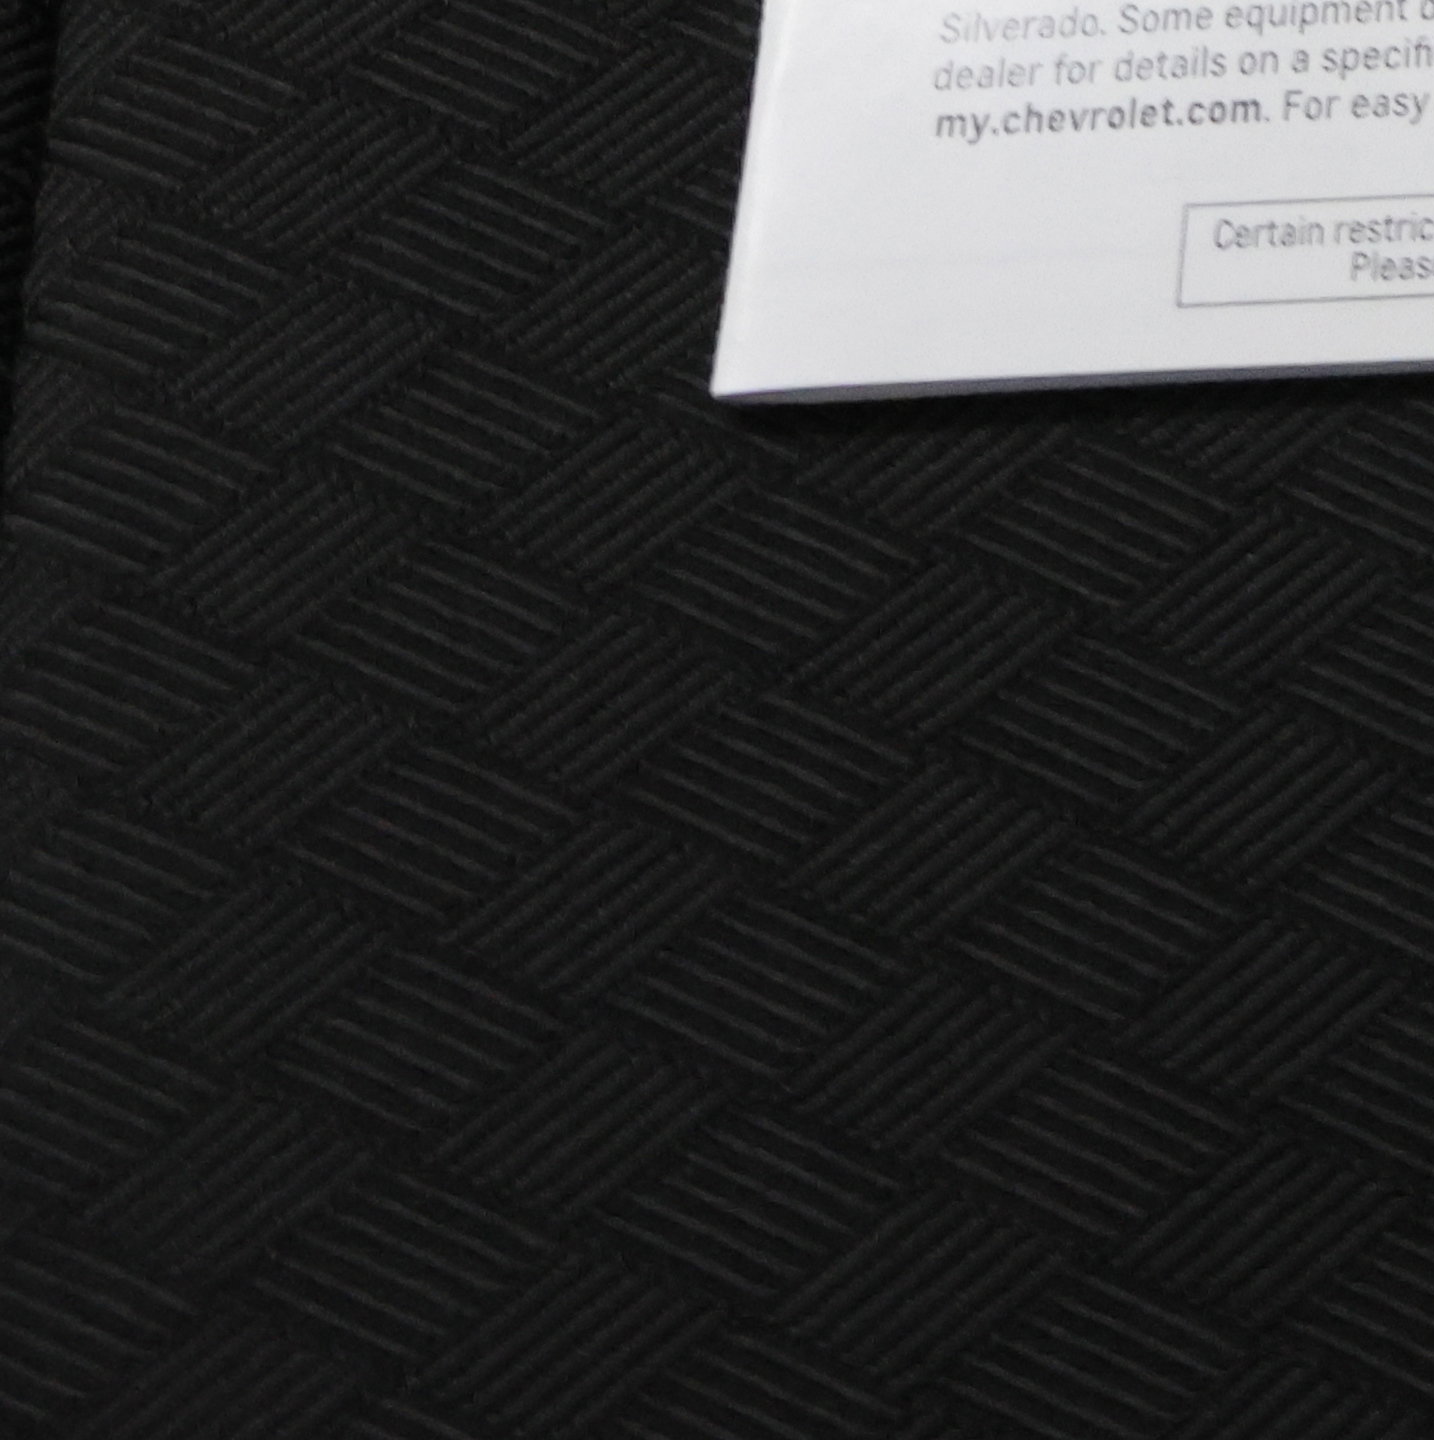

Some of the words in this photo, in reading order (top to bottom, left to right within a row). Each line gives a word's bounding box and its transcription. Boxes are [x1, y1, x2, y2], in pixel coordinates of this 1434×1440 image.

[940, 7, 1106, 44] Silverado.
[1117, 3, 1214, 35] Some
[934, 57, 1043, 90] dealer
[1054, 53, 1102, 84] for
[1113, 45, 1227, 82] details
[1237, 50, 1279, 77] on
[1290, 49, 1310, 74] a
[935, 97, 1270, 145] my.chevrolet.com.
[1283, 89, 1340, 121] For
[1350, 93, 1429, 125] easy
[1213, 217, 1325, 250] Certain
